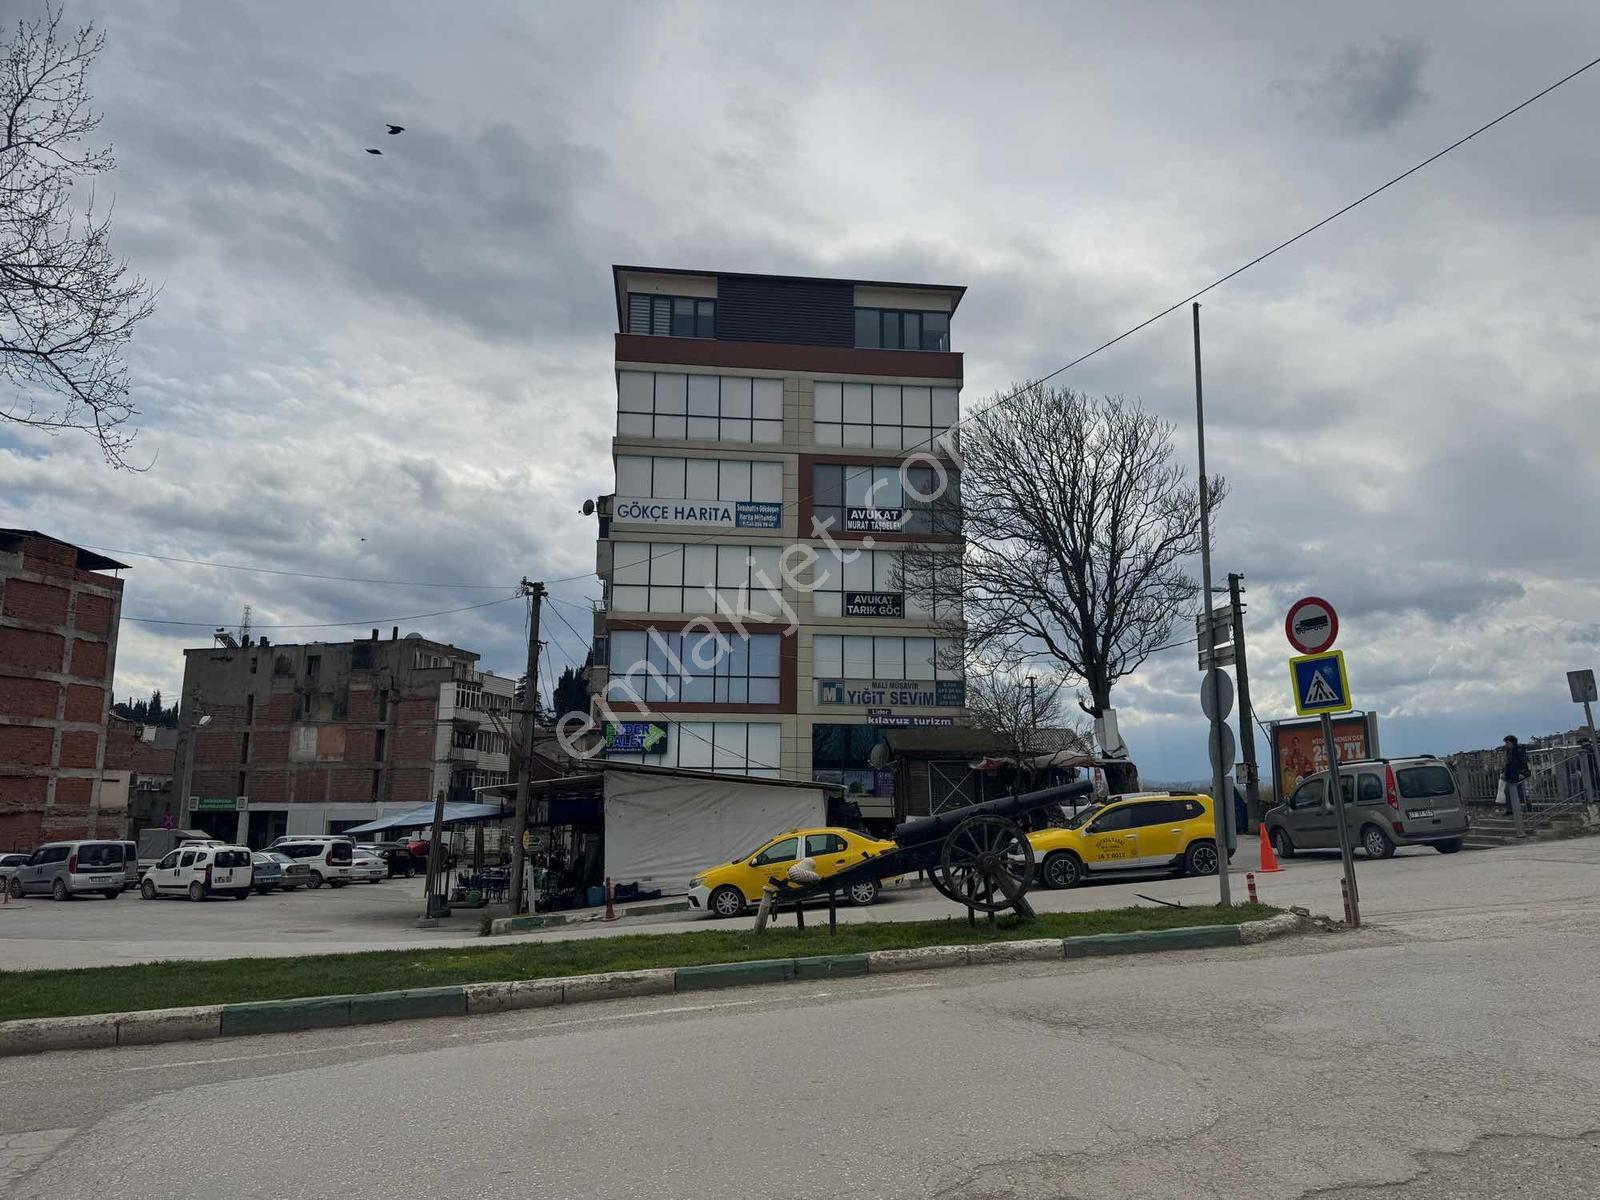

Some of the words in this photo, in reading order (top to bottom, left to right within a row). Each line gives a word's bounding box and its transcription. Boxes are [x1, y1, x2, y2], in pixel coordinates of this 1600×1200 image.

[617, 501, 669, 522] GÖKÇE
[851, 510, 899, 520] AVUKAT
[847, 520, 869, 530] MURAT
[854, 595, 894, 605] AVUKAT
[847, 605, 877, 615] TARIK
[879, 605, 900, 617] GÖÇ
[914, 717, 951, 725] turizm
[606, 735, 646, 747] PALET
[1344, 741, 1366, 760] TL
